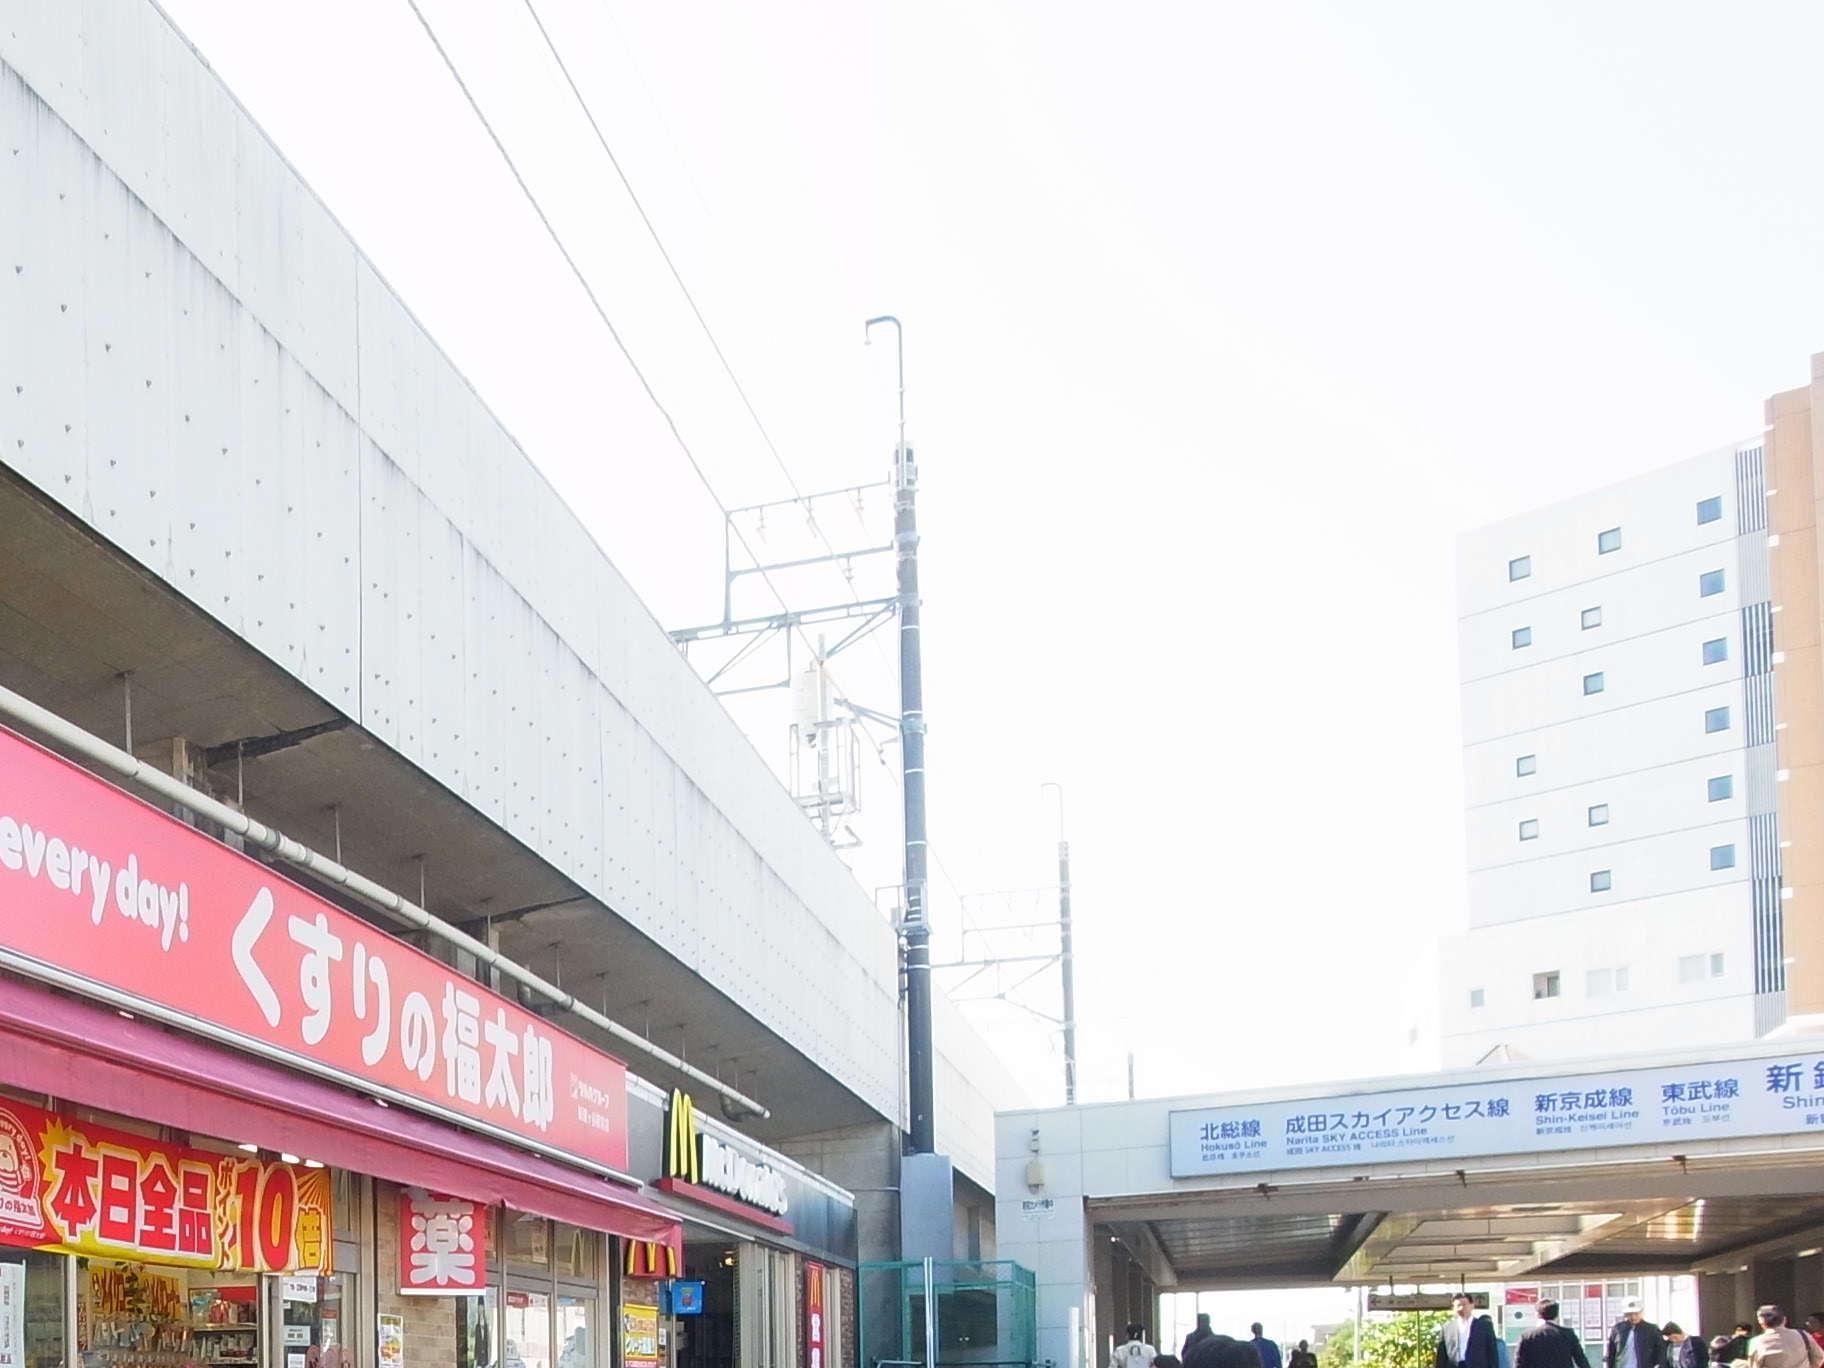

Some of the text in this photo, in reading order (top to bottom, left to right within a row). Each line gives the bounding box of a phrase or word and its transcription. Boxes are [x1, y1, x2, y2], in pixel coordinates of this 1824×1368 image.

[115, 853, 190, 952] day!
[230, 886, 555, 1132] くすりの福太郎
[1534, 1087, 1633, 1113] 新京成線
[1661, 1078, 1740, 1103] 東武線
[1285, 1097, 1511, 1135] 成田スカイアクセス線
[1535, 1109, 1639, 1125] Shin-Keisei Line
[1700, 1101, 1730, 1112] Line
[1200, 1119, 1262, 1141] 北総線
[1286, 1127, 1428, 1146] Narita SKY ACCESS Line
[1244, 1139, 1267, 1149] Line
[50, 1143, 214, 1257] 本日全品
